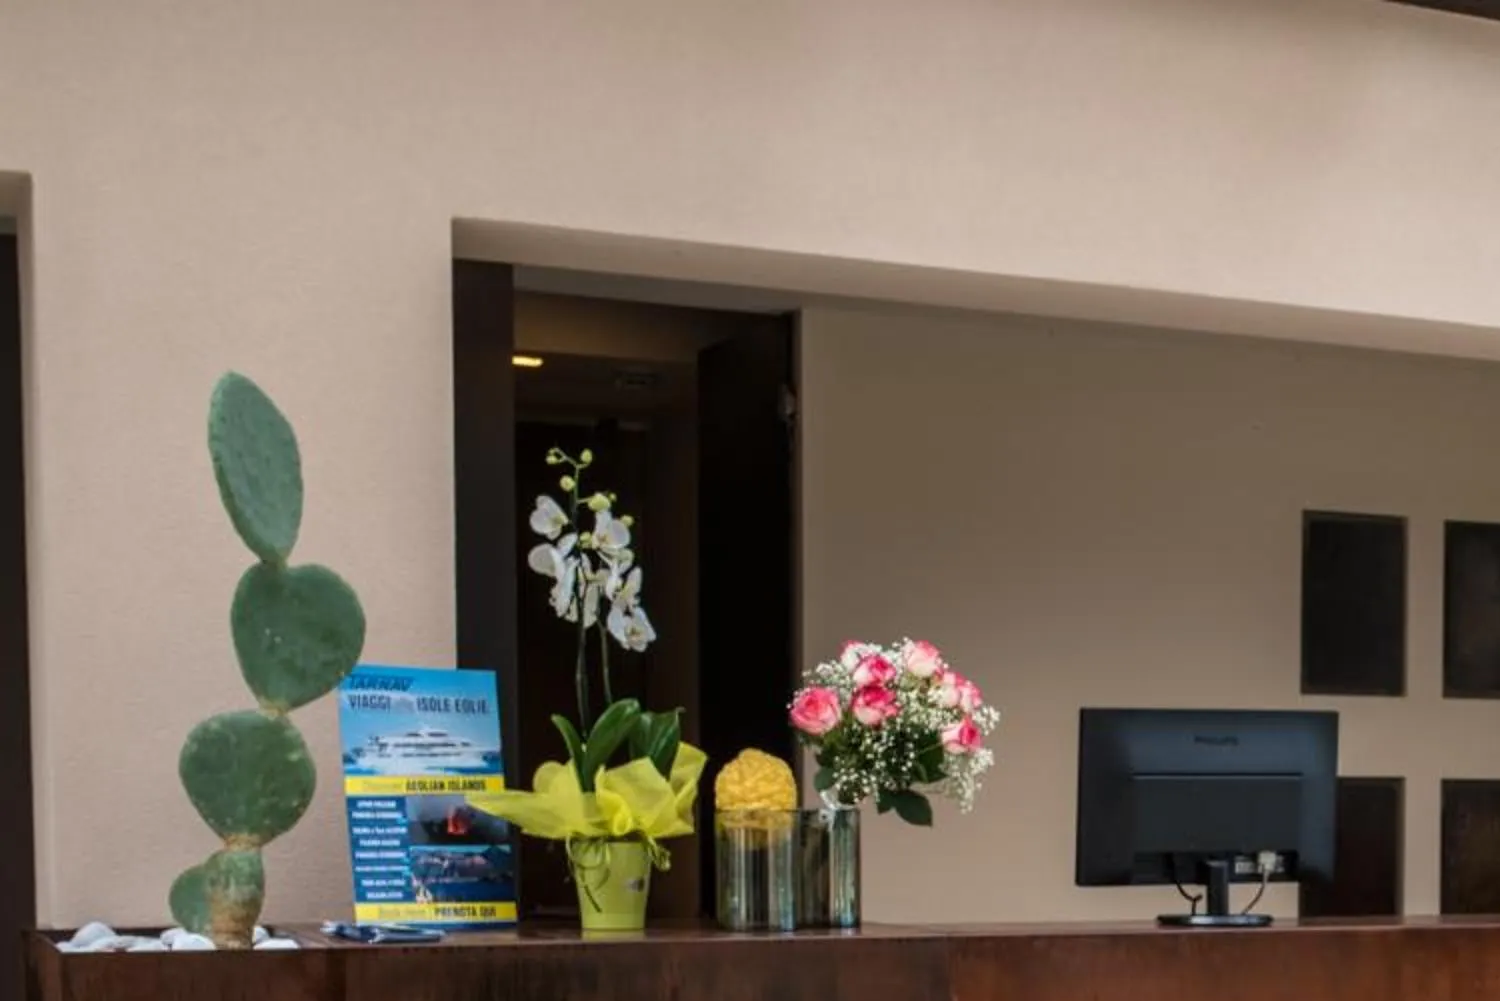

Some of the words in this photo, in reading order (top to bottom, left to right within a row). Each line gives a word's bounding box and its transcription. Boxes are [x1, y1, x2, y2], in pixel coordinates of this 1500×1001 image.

[348, 694, 391, 713] VIAGGI
[416, 696, 451, 713] ISOLE
[455, 698, 488, 714] EOLIE
